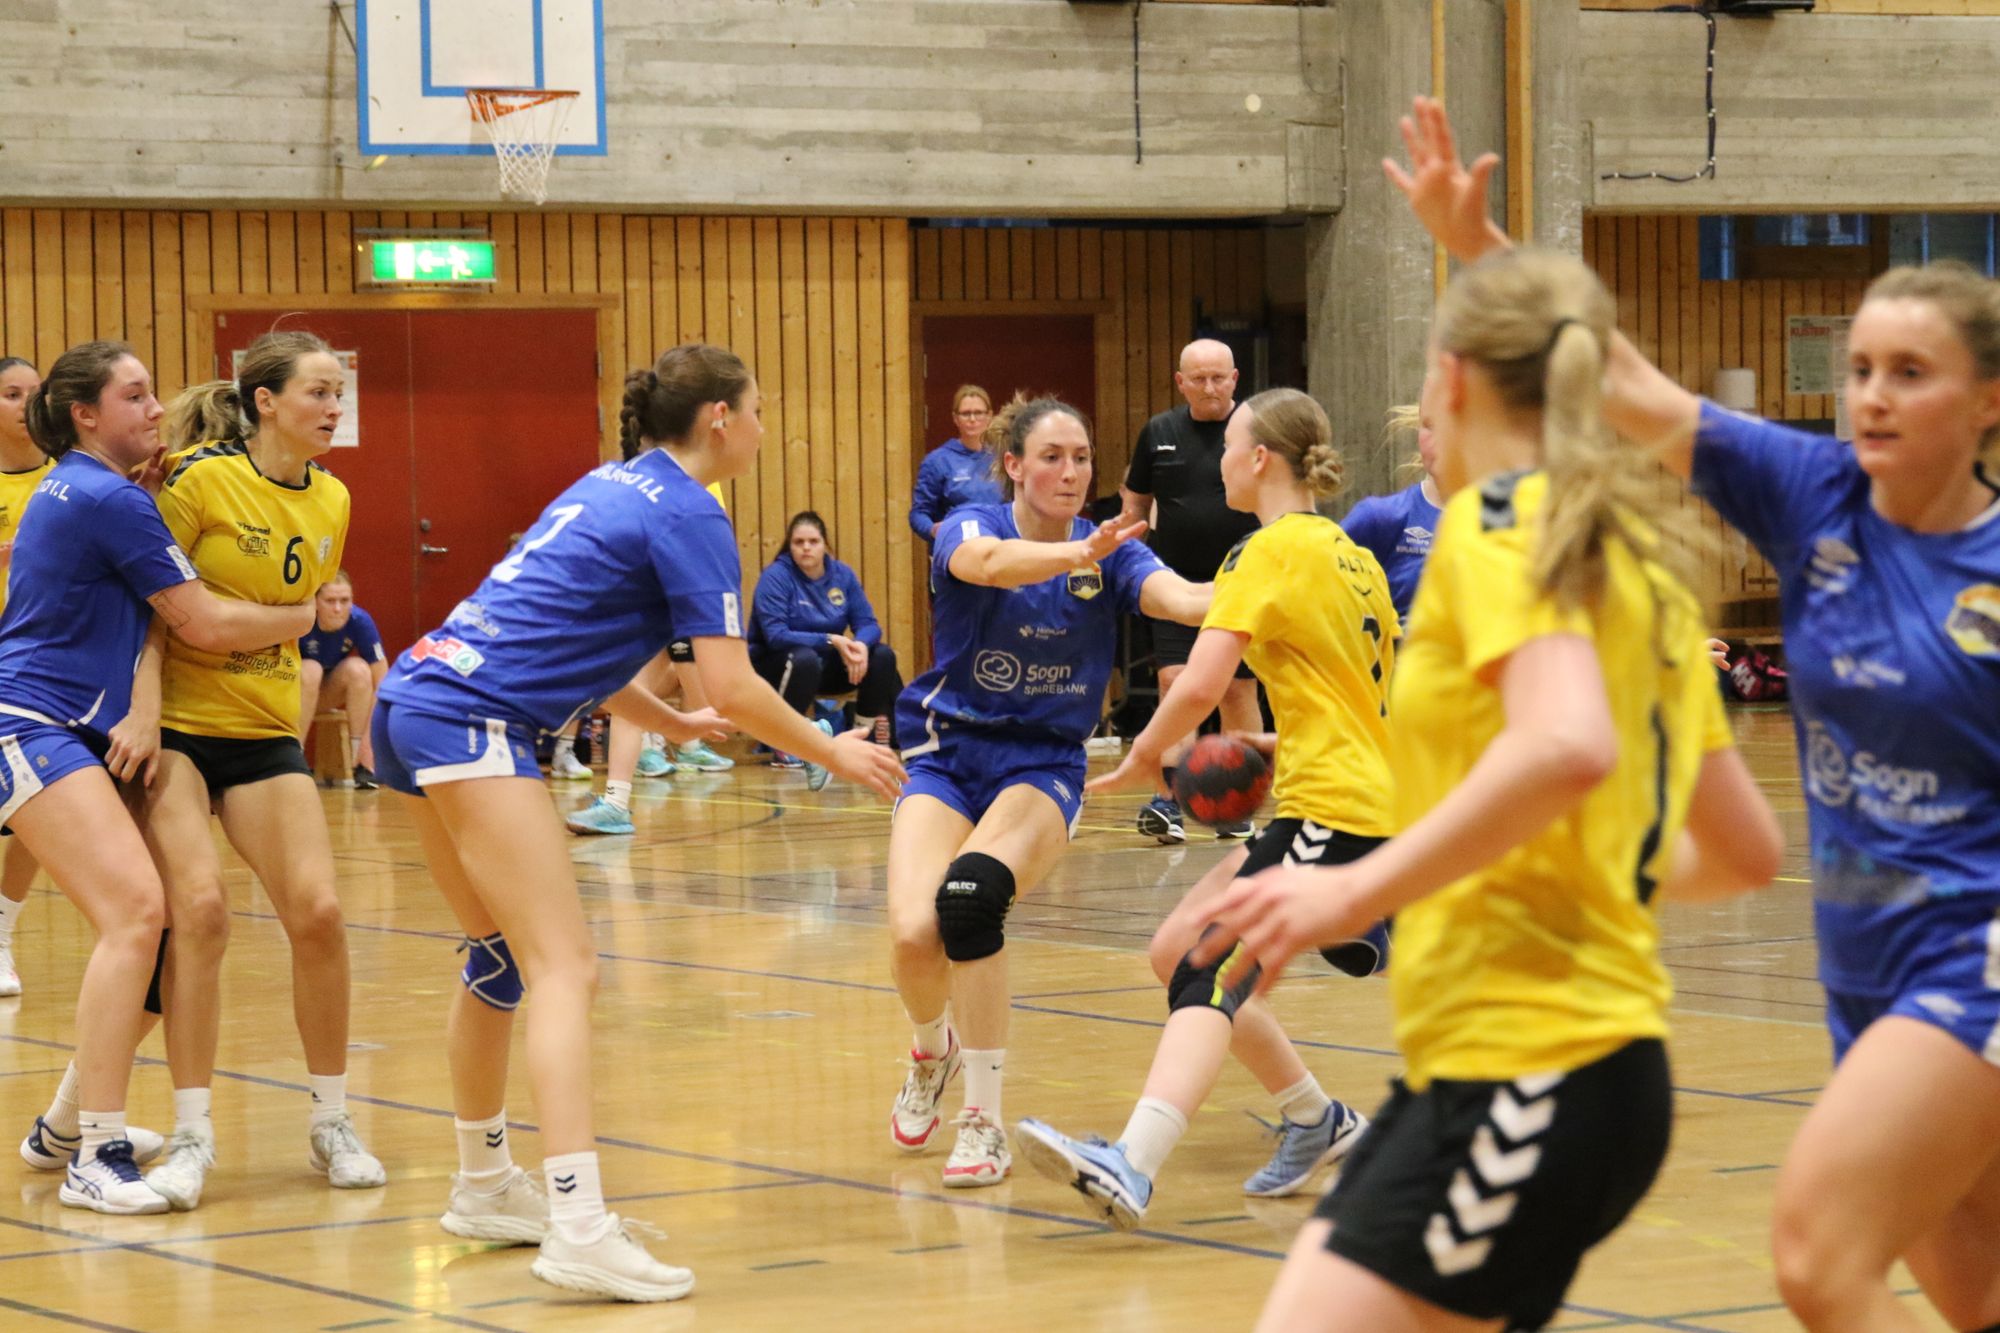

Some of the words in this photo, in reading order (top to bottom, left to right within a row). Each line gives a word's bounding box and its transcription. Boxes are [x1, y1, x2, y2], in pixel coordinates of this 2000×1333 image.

[283, 535, 305, 585] 6
[1026, 664, 1072, 684] Sogn
[1850, 751, 1939, 804] Sogn
[946, 881, 977, 890] SELECT
